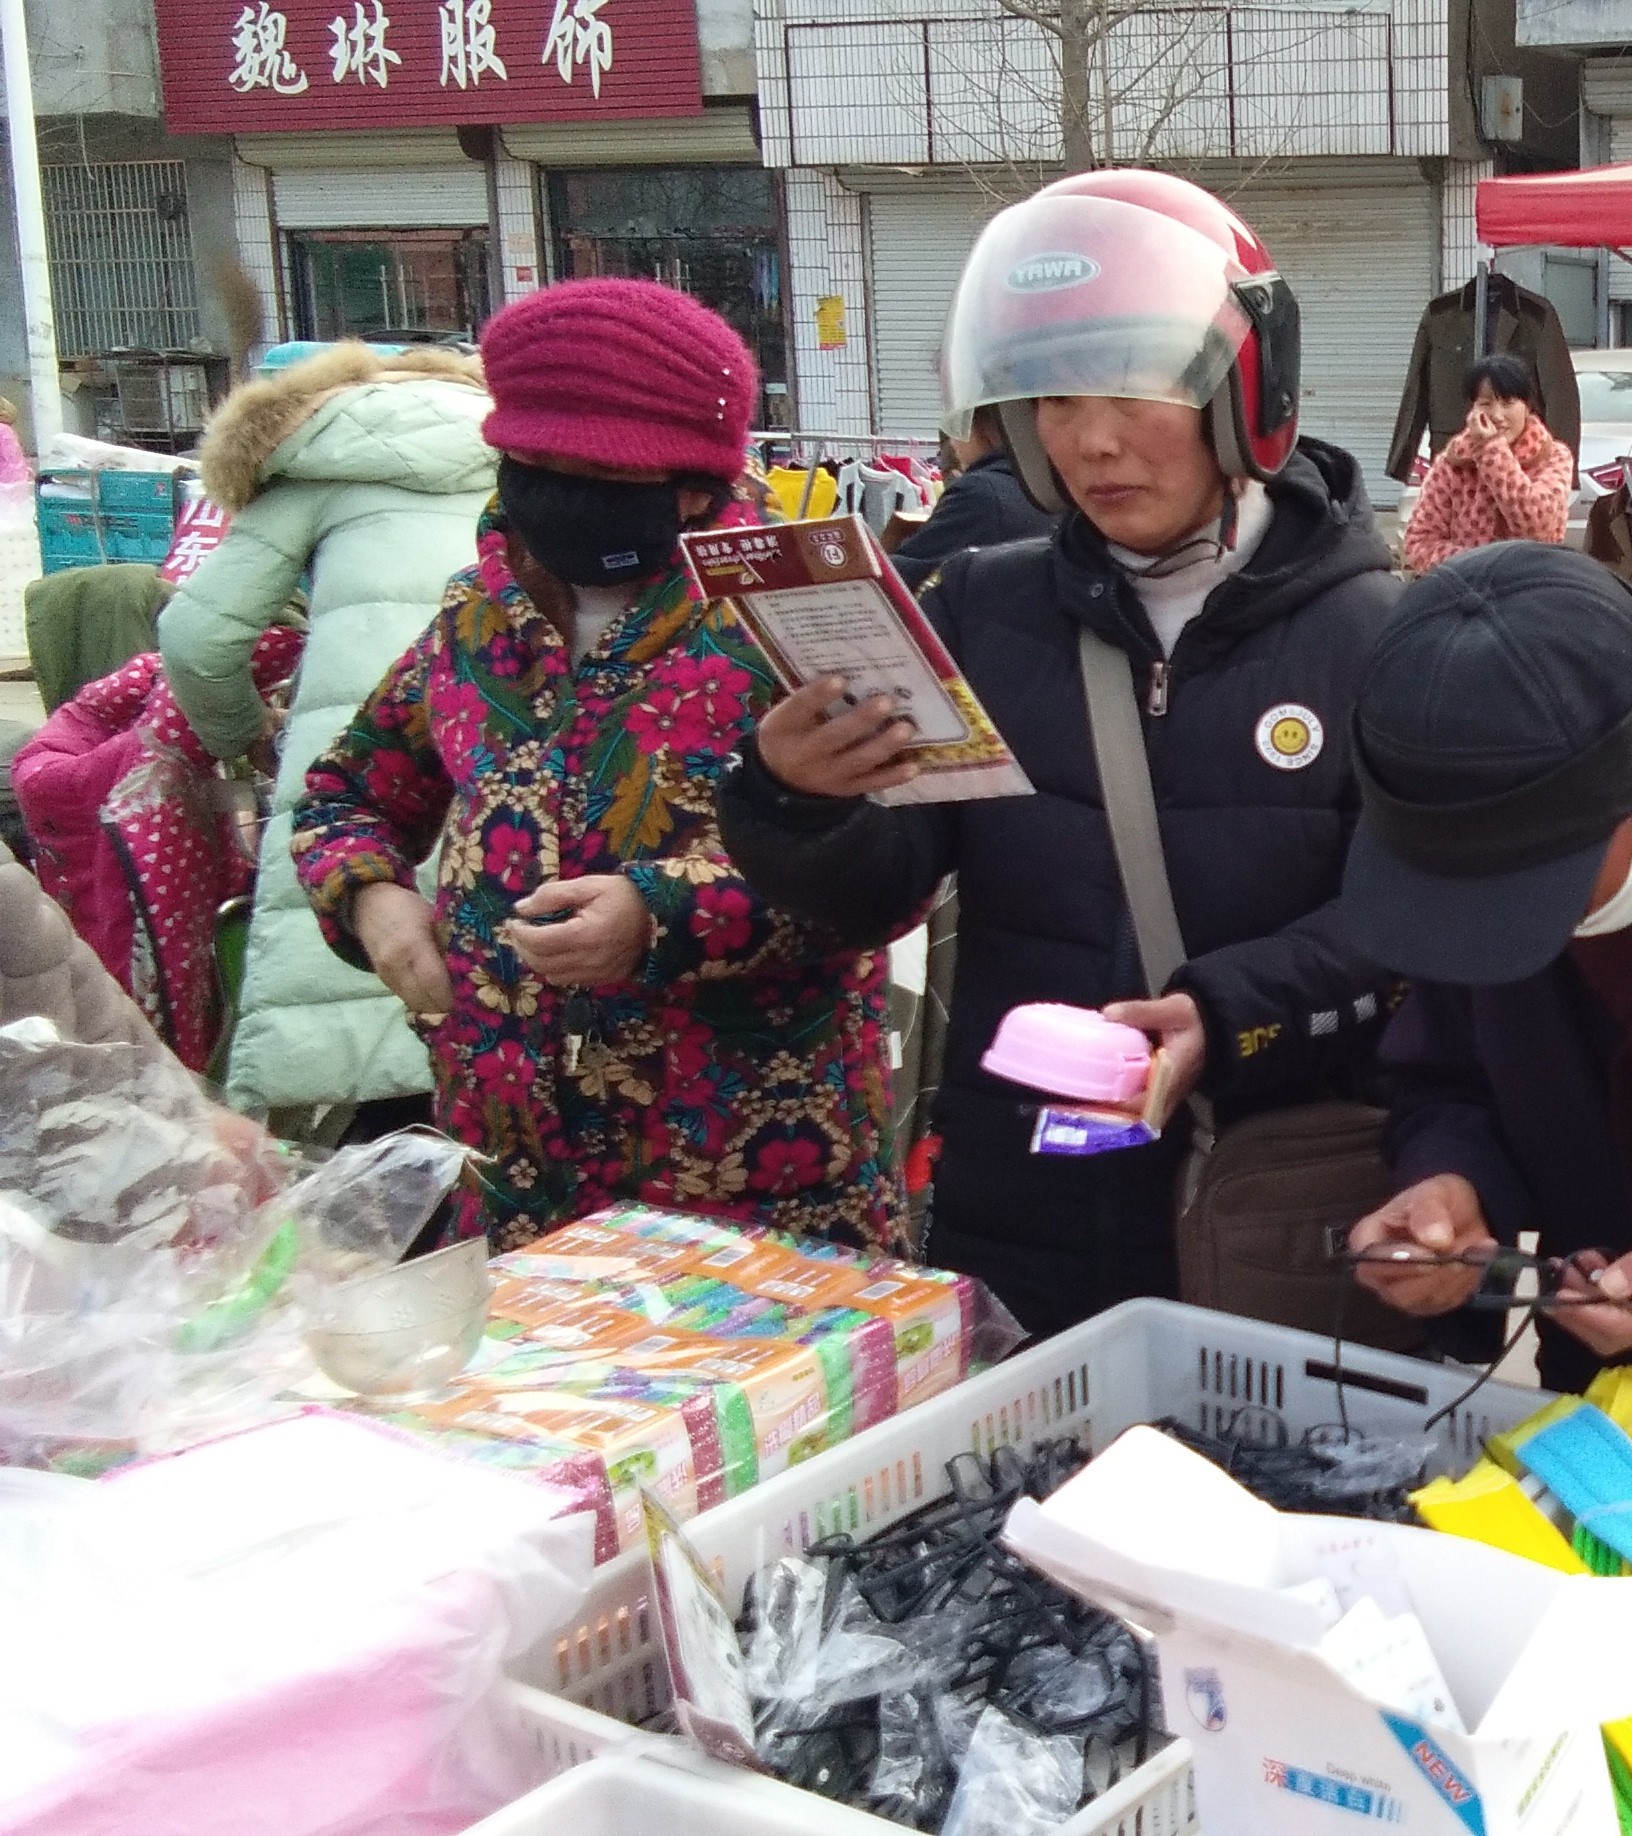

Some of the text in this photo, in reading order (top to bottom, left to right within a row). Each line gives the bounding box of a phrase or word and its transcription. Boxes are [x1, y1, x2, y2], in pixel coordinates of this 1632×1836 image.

[229, 0, 612, 99] 魏琳服饰
[1414, 1741, 1471, 1803] NEW
